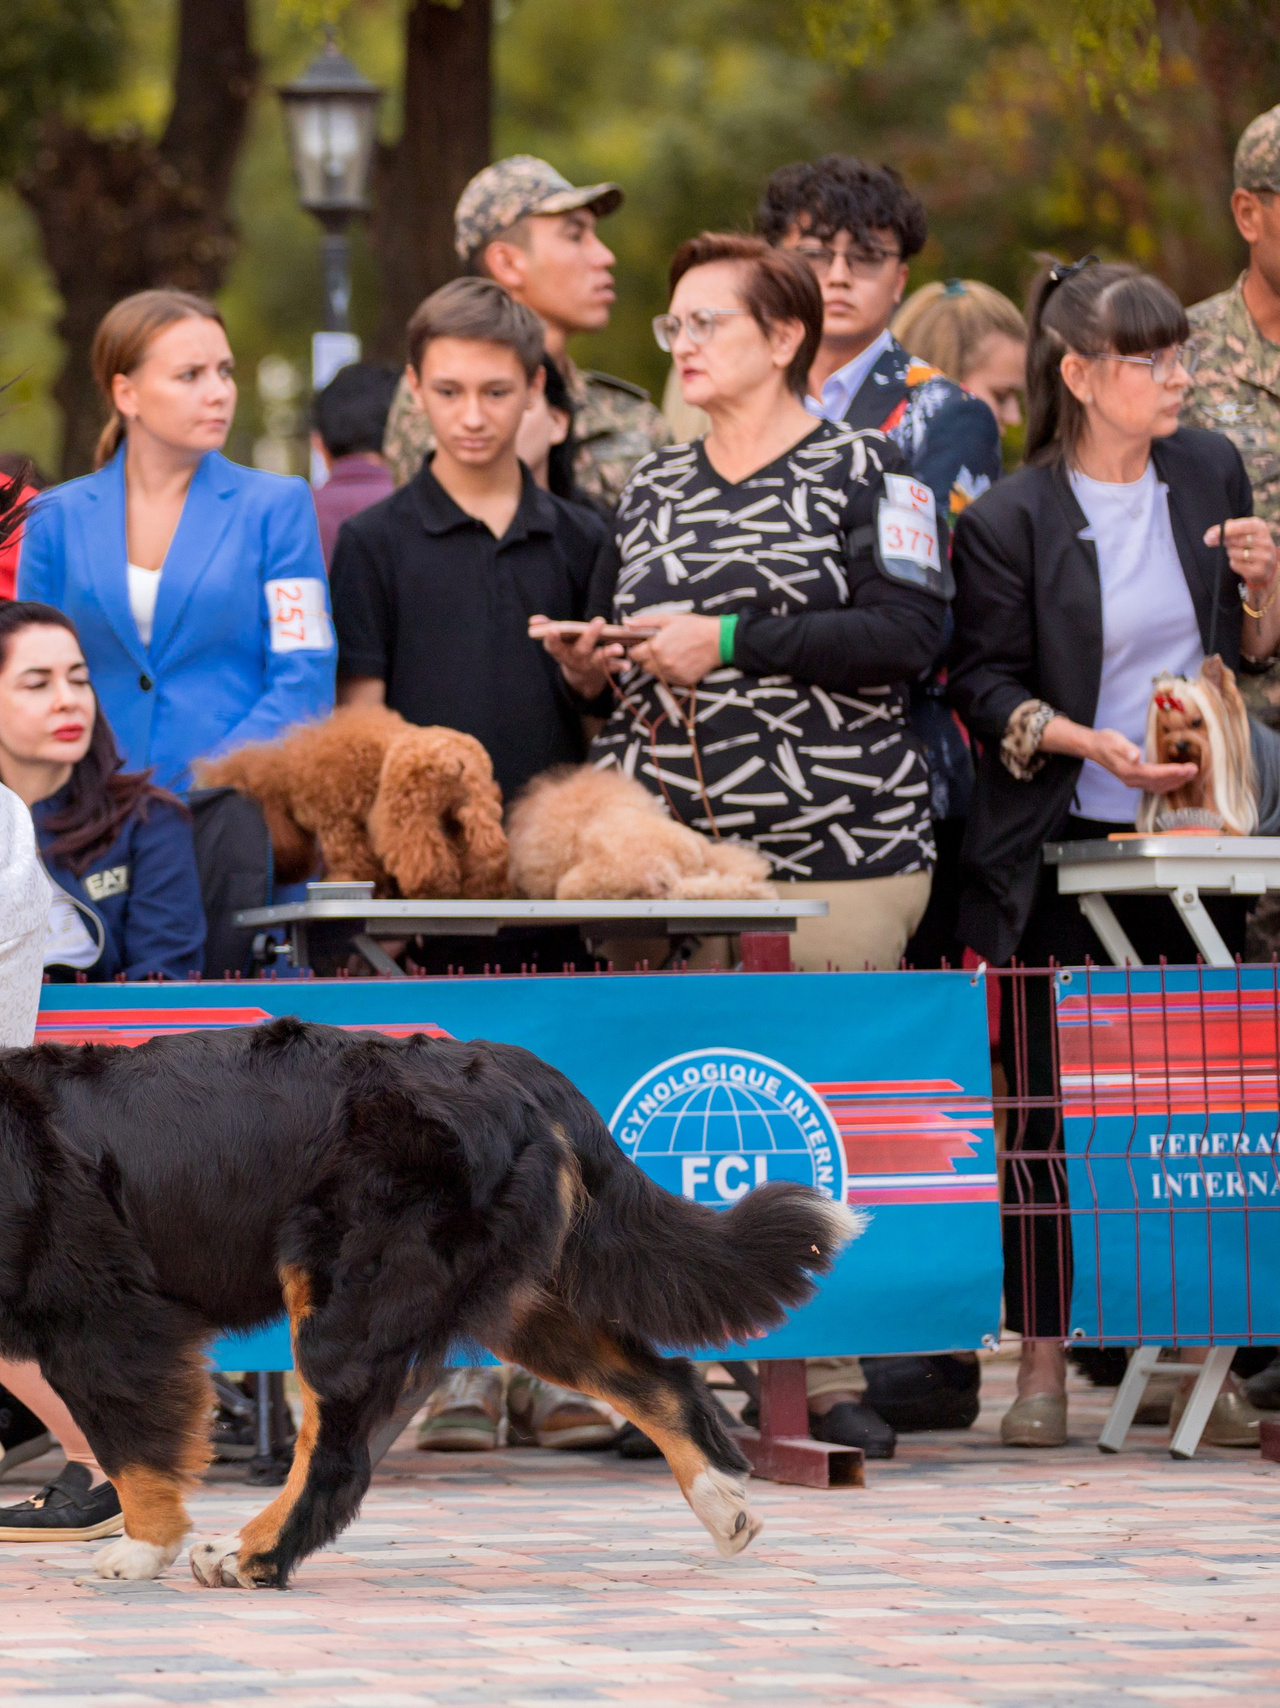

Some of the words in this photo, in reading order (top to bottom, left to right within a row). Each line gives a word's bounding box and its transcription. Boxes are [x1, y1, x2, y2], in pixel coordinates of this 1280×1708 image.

[886, 525, 934, 557] 377
[276, 586, 305, 641] 257
[86, 865, 129, 900] EA7
[620, 1062, 782, 1145] CYNOLOGIQUE
[682, 1155, 768, 1200] FCI
